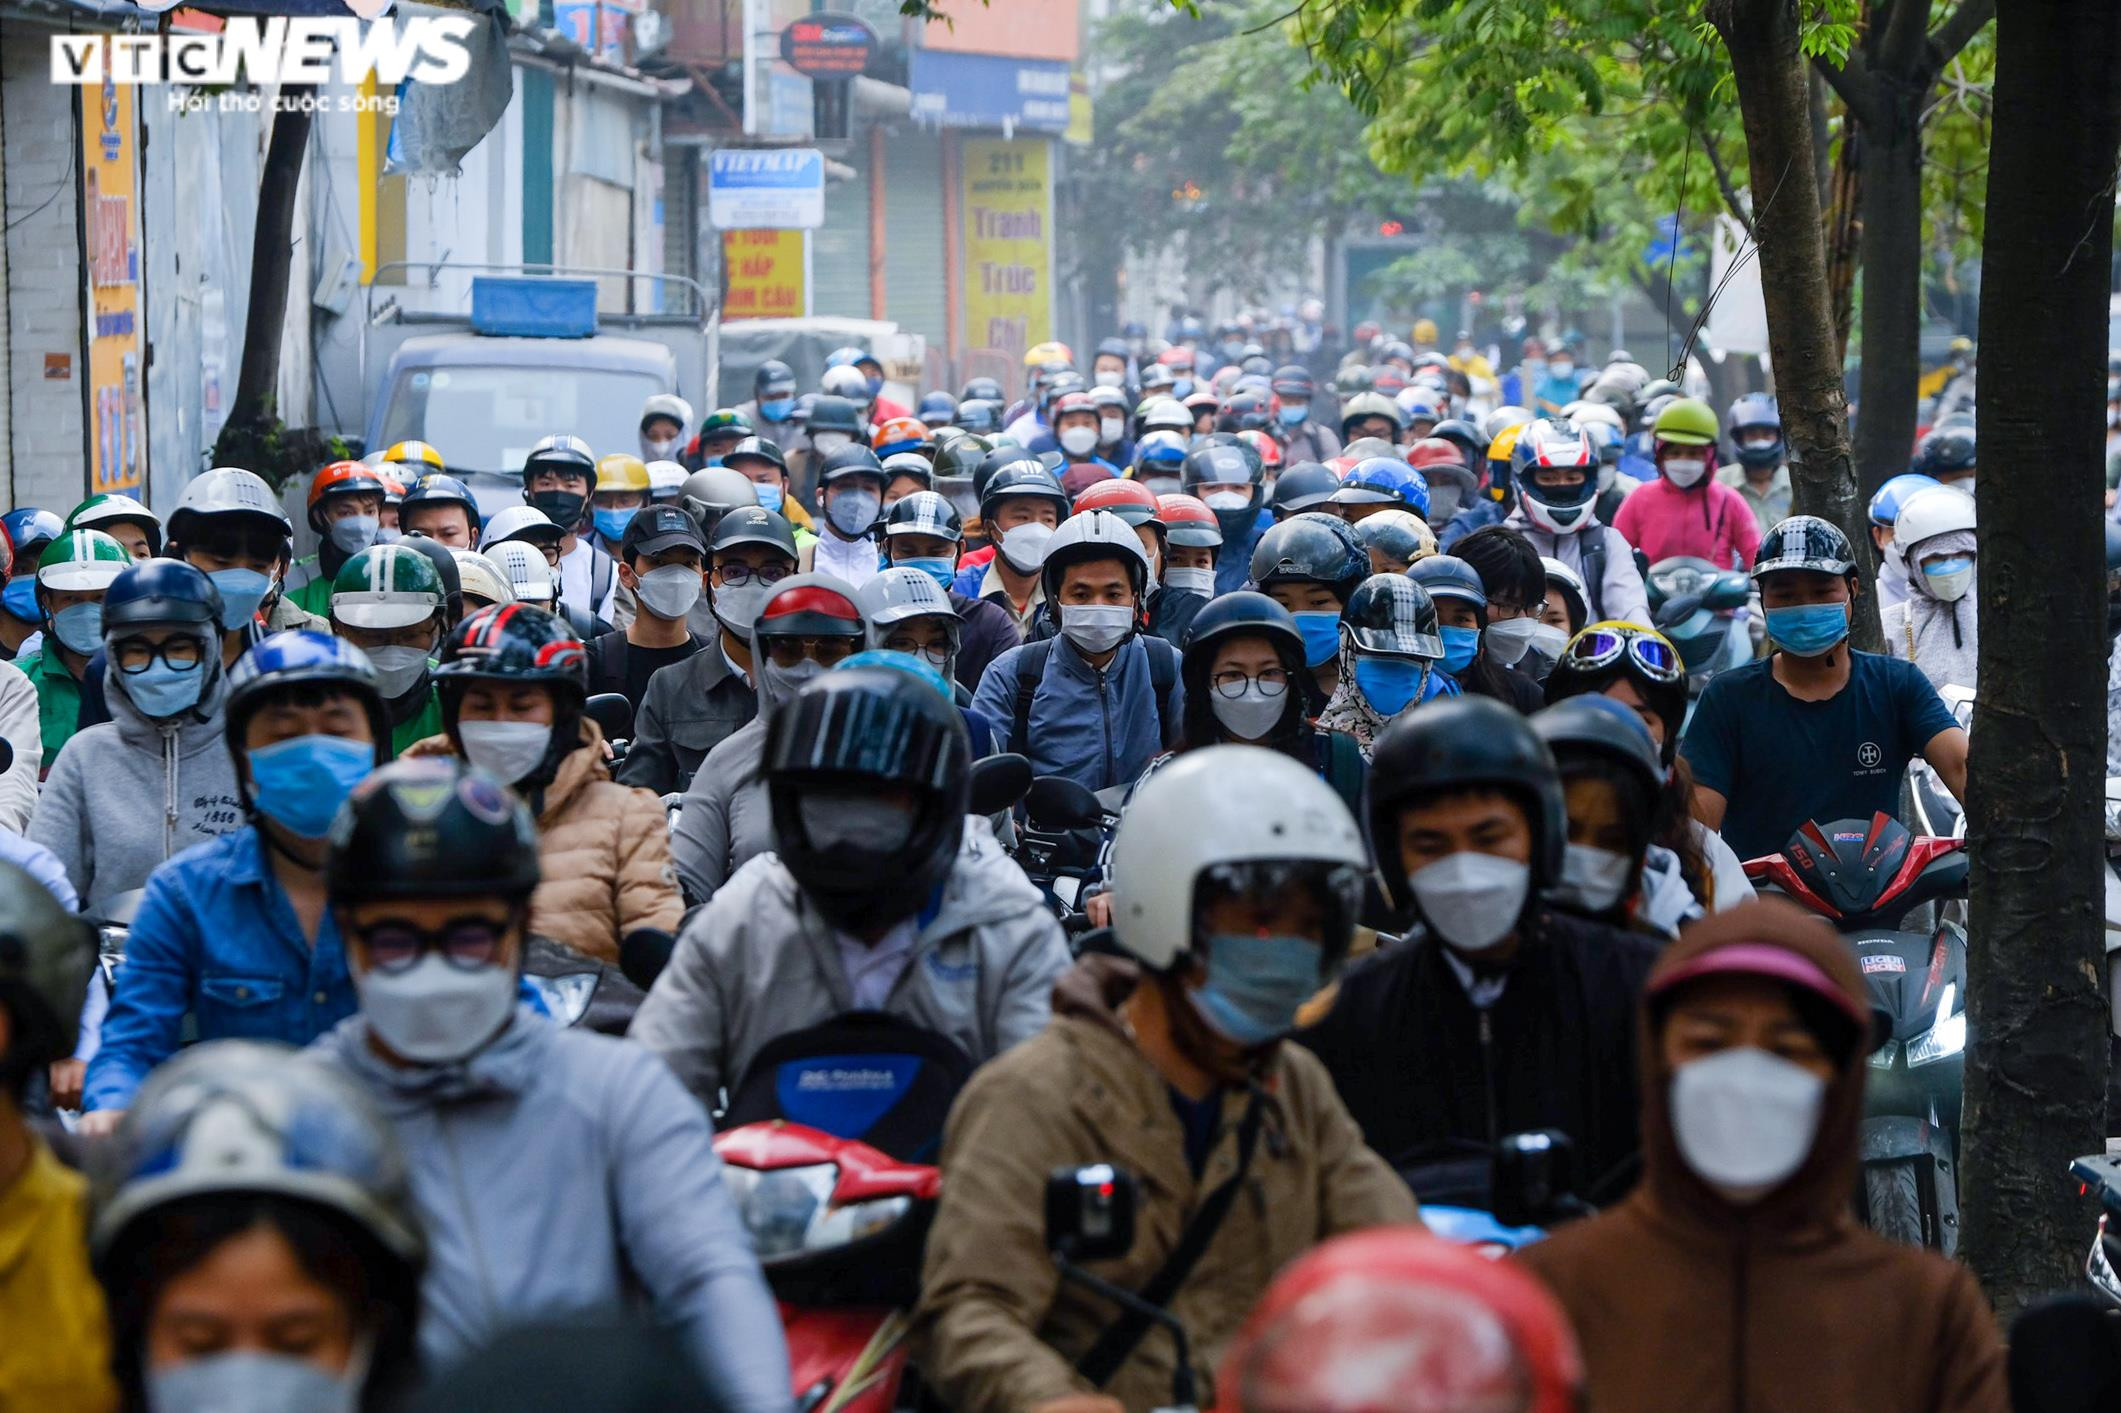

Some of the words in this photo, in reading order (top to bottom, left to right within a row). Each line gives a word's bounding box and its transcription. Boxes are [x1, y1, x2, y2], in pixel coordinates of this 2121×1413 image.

[973, 206, 1042, 240] Tranh
[1789, 842, 1816, 870] 150
[1857, 938, 1895, 946] HONDA
[1863, 955, 1901, 964] LIQUI
[1865, 963, 1905, 973] MOLY
